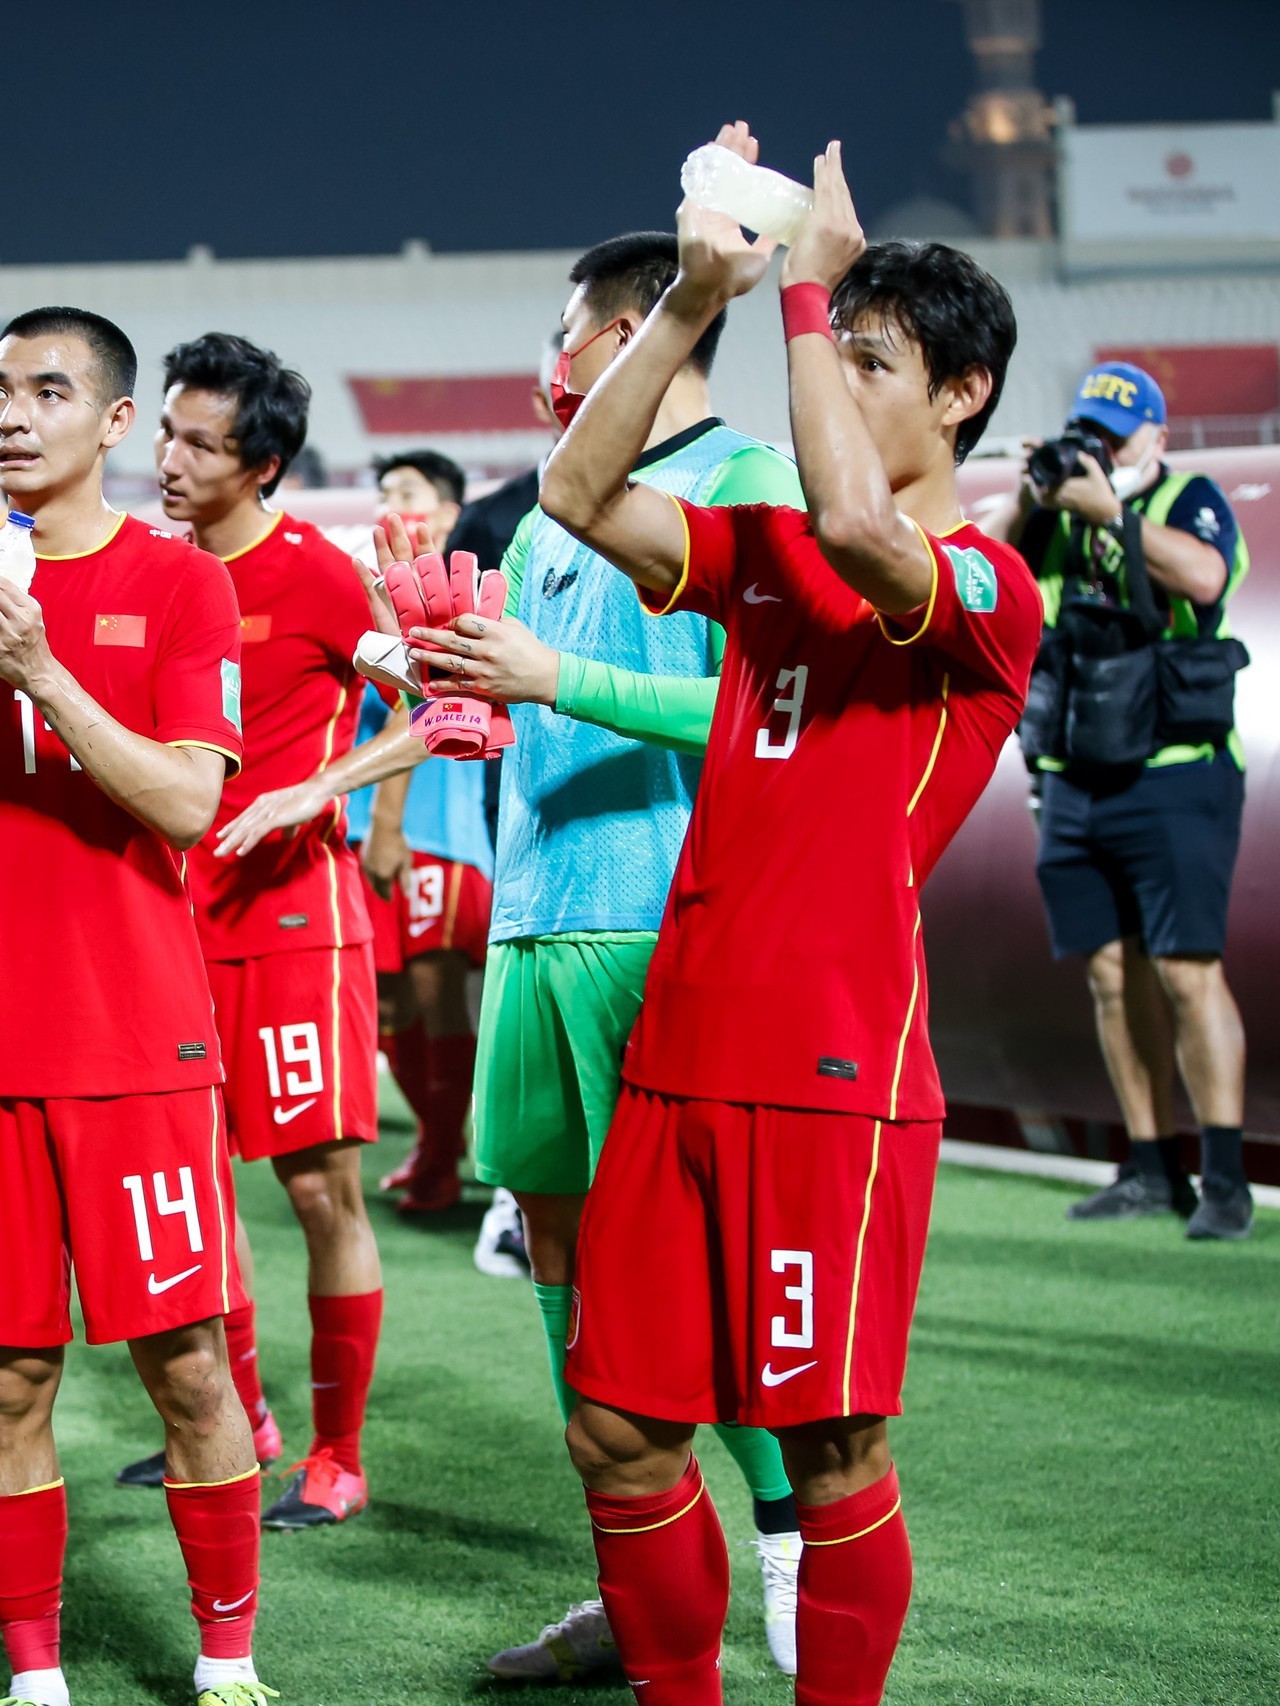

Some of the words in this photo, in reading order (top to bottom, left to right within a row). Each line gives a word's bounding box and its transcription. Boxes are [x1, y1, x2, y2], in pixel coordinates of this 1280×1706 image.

[14, 689, 82, 774] 1
[754, 665, 809, 760] 3
[258, 1022, 324, 1098] 19
[122, 1166, 204, 1261] 14
[771, 1249, 814, 1349] 3
